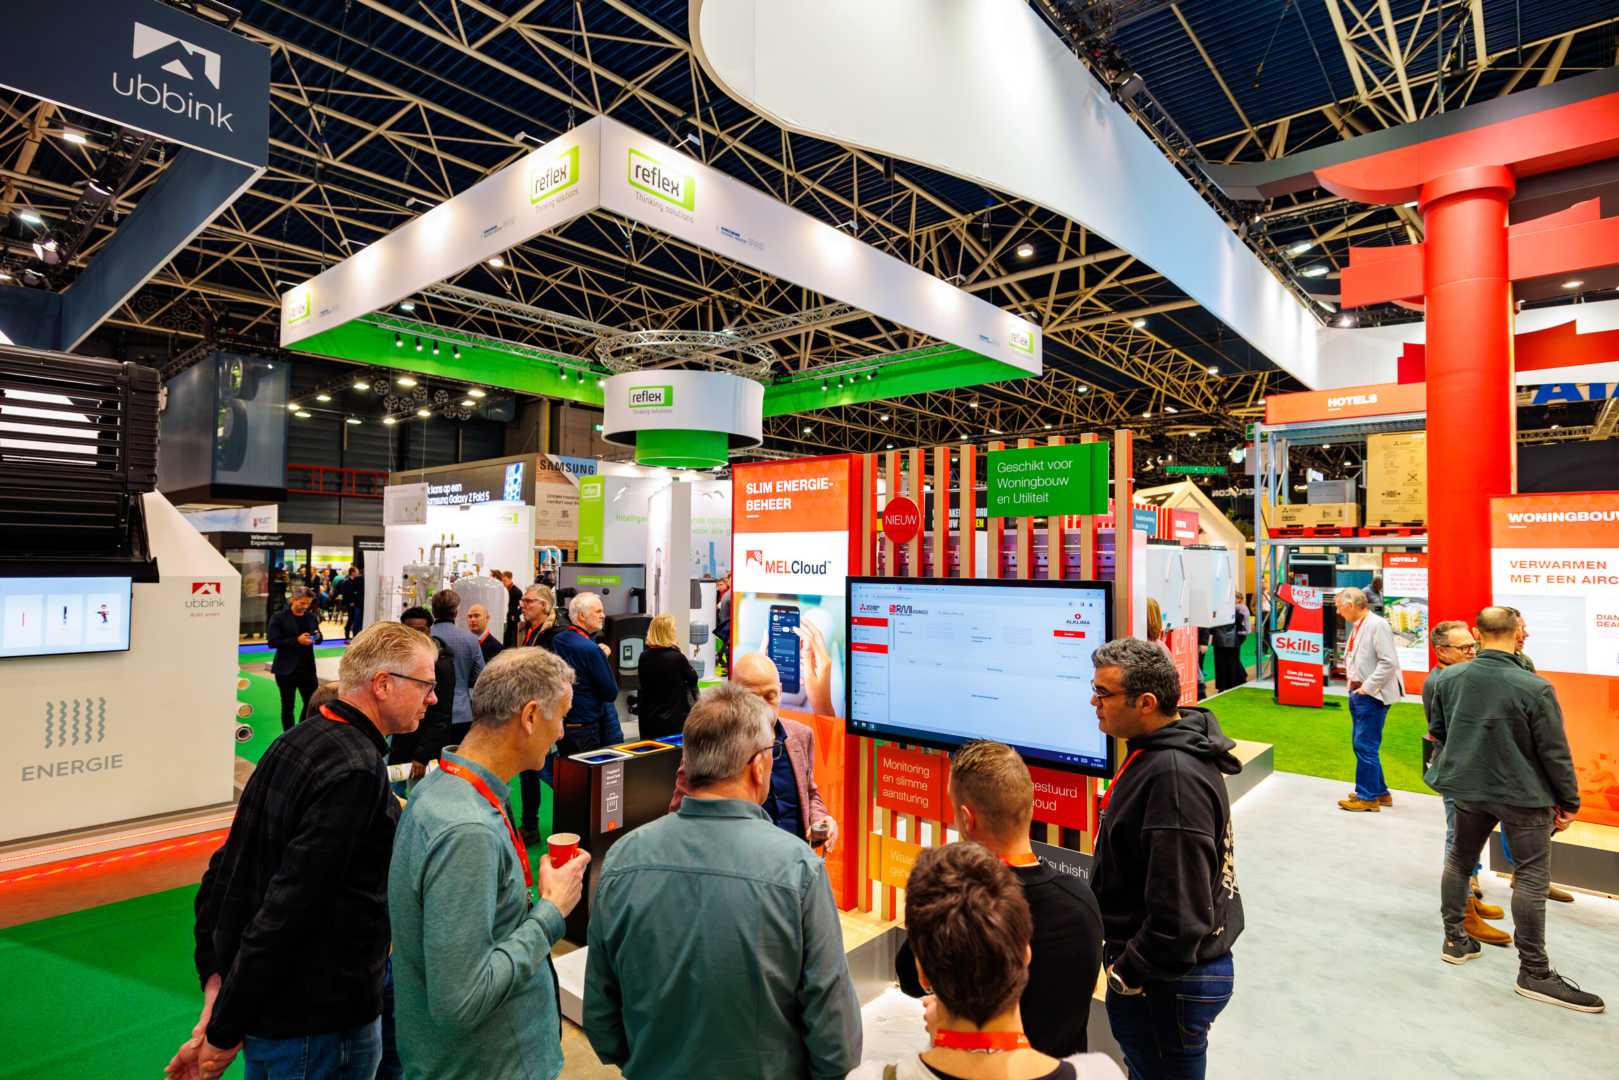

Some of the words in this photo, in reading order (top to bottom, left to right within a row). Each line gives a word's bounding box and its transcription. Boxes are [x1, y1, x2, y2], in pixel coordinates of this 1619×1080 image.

[112, 72, 233, 132] ubbink
[534, 164, 568, 194] reflex
[634, 163, 681, 197] reflex
[632, 390, 662, 403] reflex
[1327, 393, 1378, 407] HOTELS
[539, 460, 595, 475] SAMSUNG
[997, 460, 1044, 474] Geschikt
[1047, 460, 1072, 470] voor
[746, 482, 773, 494] SLIM
[776, 477, 834, 493] ENERGIE-
[997, 476, 1070, 490] Woningbouw
[746, 498, 792, 511] BEHEER
[997, 496, 1010, 505] en
[1013, 492, 1049, 504] Utiliteit
[885, 514, 917, 526] NIEUW
[1510, 560, 1607, 570] VERWARMEN
[1510, 575, 1541, 584] MET
[1546, 575, 1576, 584] EEN
[1292, 587, 1317, 599] test
[184, 598, 225, 608] ubbink
[1275, 637, 1321, 653] Skills
[22, 753, 123, 782] ENERGIE
[883, 757, 930, 779] Monitoring
[882, 774, 894, 783] en
[895, 776, 928, 791] slimme
[882, 788, 929, 809] aansturing
